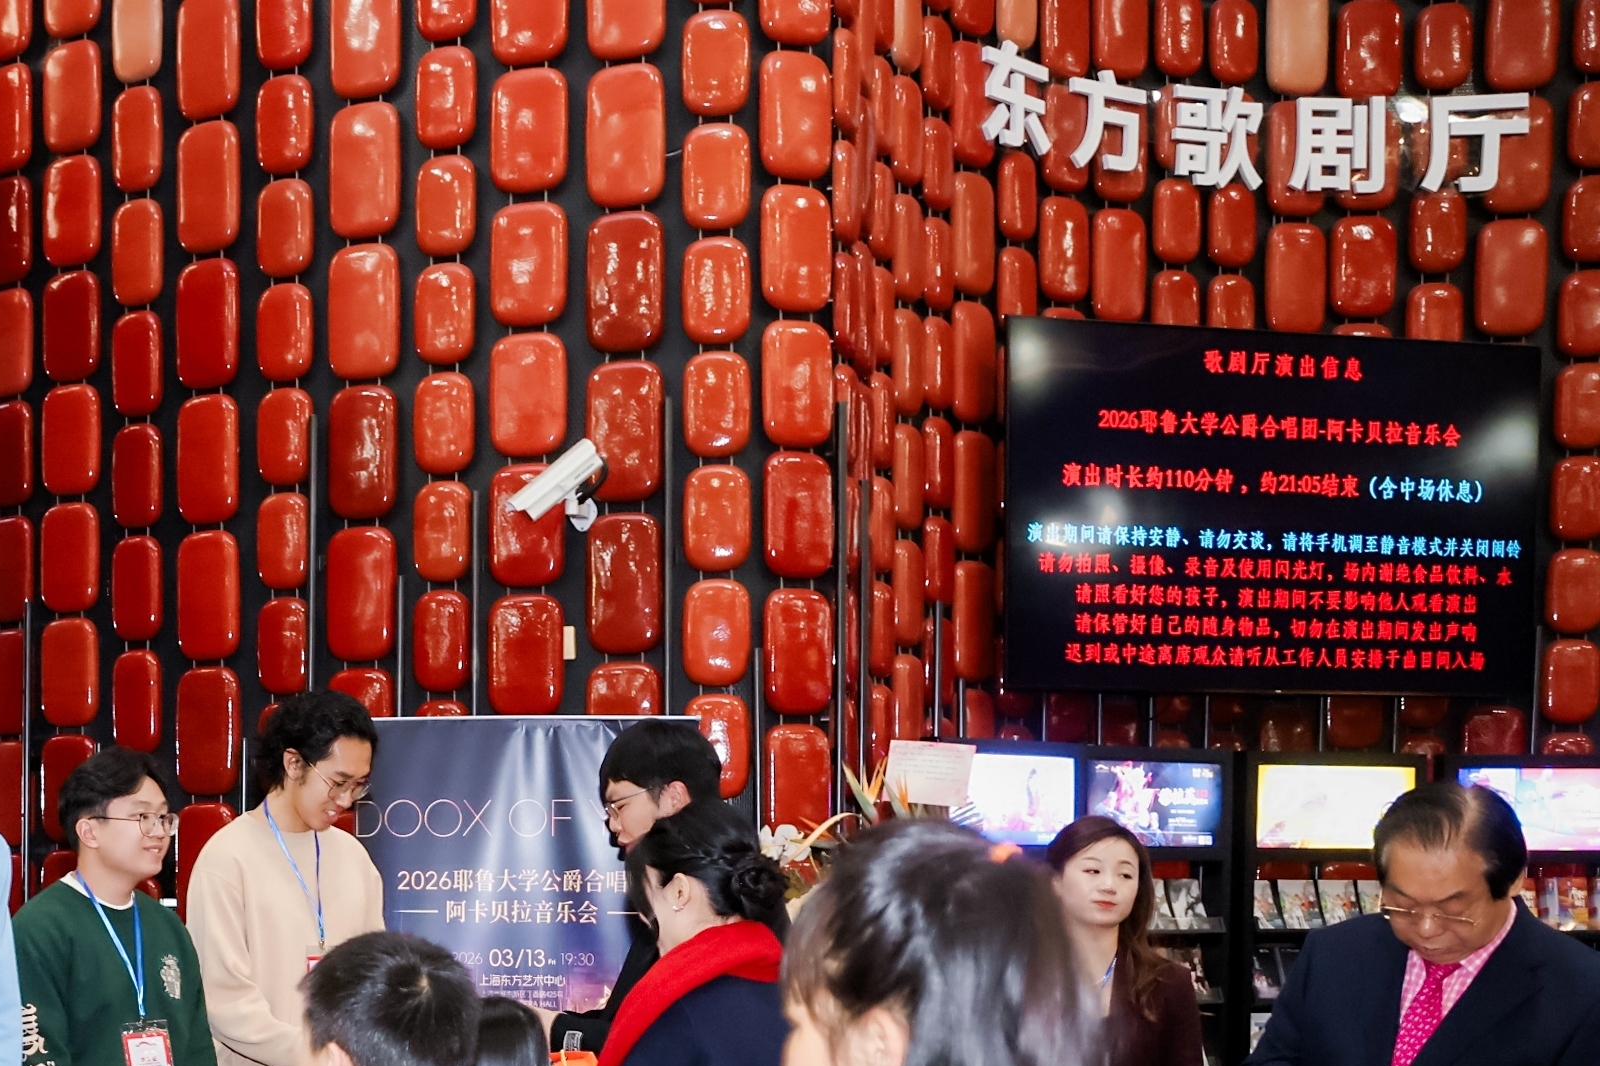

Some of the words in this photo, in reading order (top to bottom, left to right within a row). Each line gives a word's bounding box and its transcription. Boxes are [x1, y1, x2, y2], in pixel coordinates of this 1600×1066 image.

[981, 39, 1530, 193] 东方歌剧厅
[1203, 350, 1363, 381] 歌剧厅演出信息
[1098, 409, 1462, 447] 2026耶鲁大学公爵合唱团-阿卡贝拉音乐会
[355, 799, 492, 837] DOOX
[508, 799, 573, 837] OF
[446, 900, 598, 924] 阿卡贝拉音乐会
[489, 949, 546, 968] 03/13
[560, 952, 595, 966] 19:30
[480, 974, 565, 987] 上海东方艺术中心
